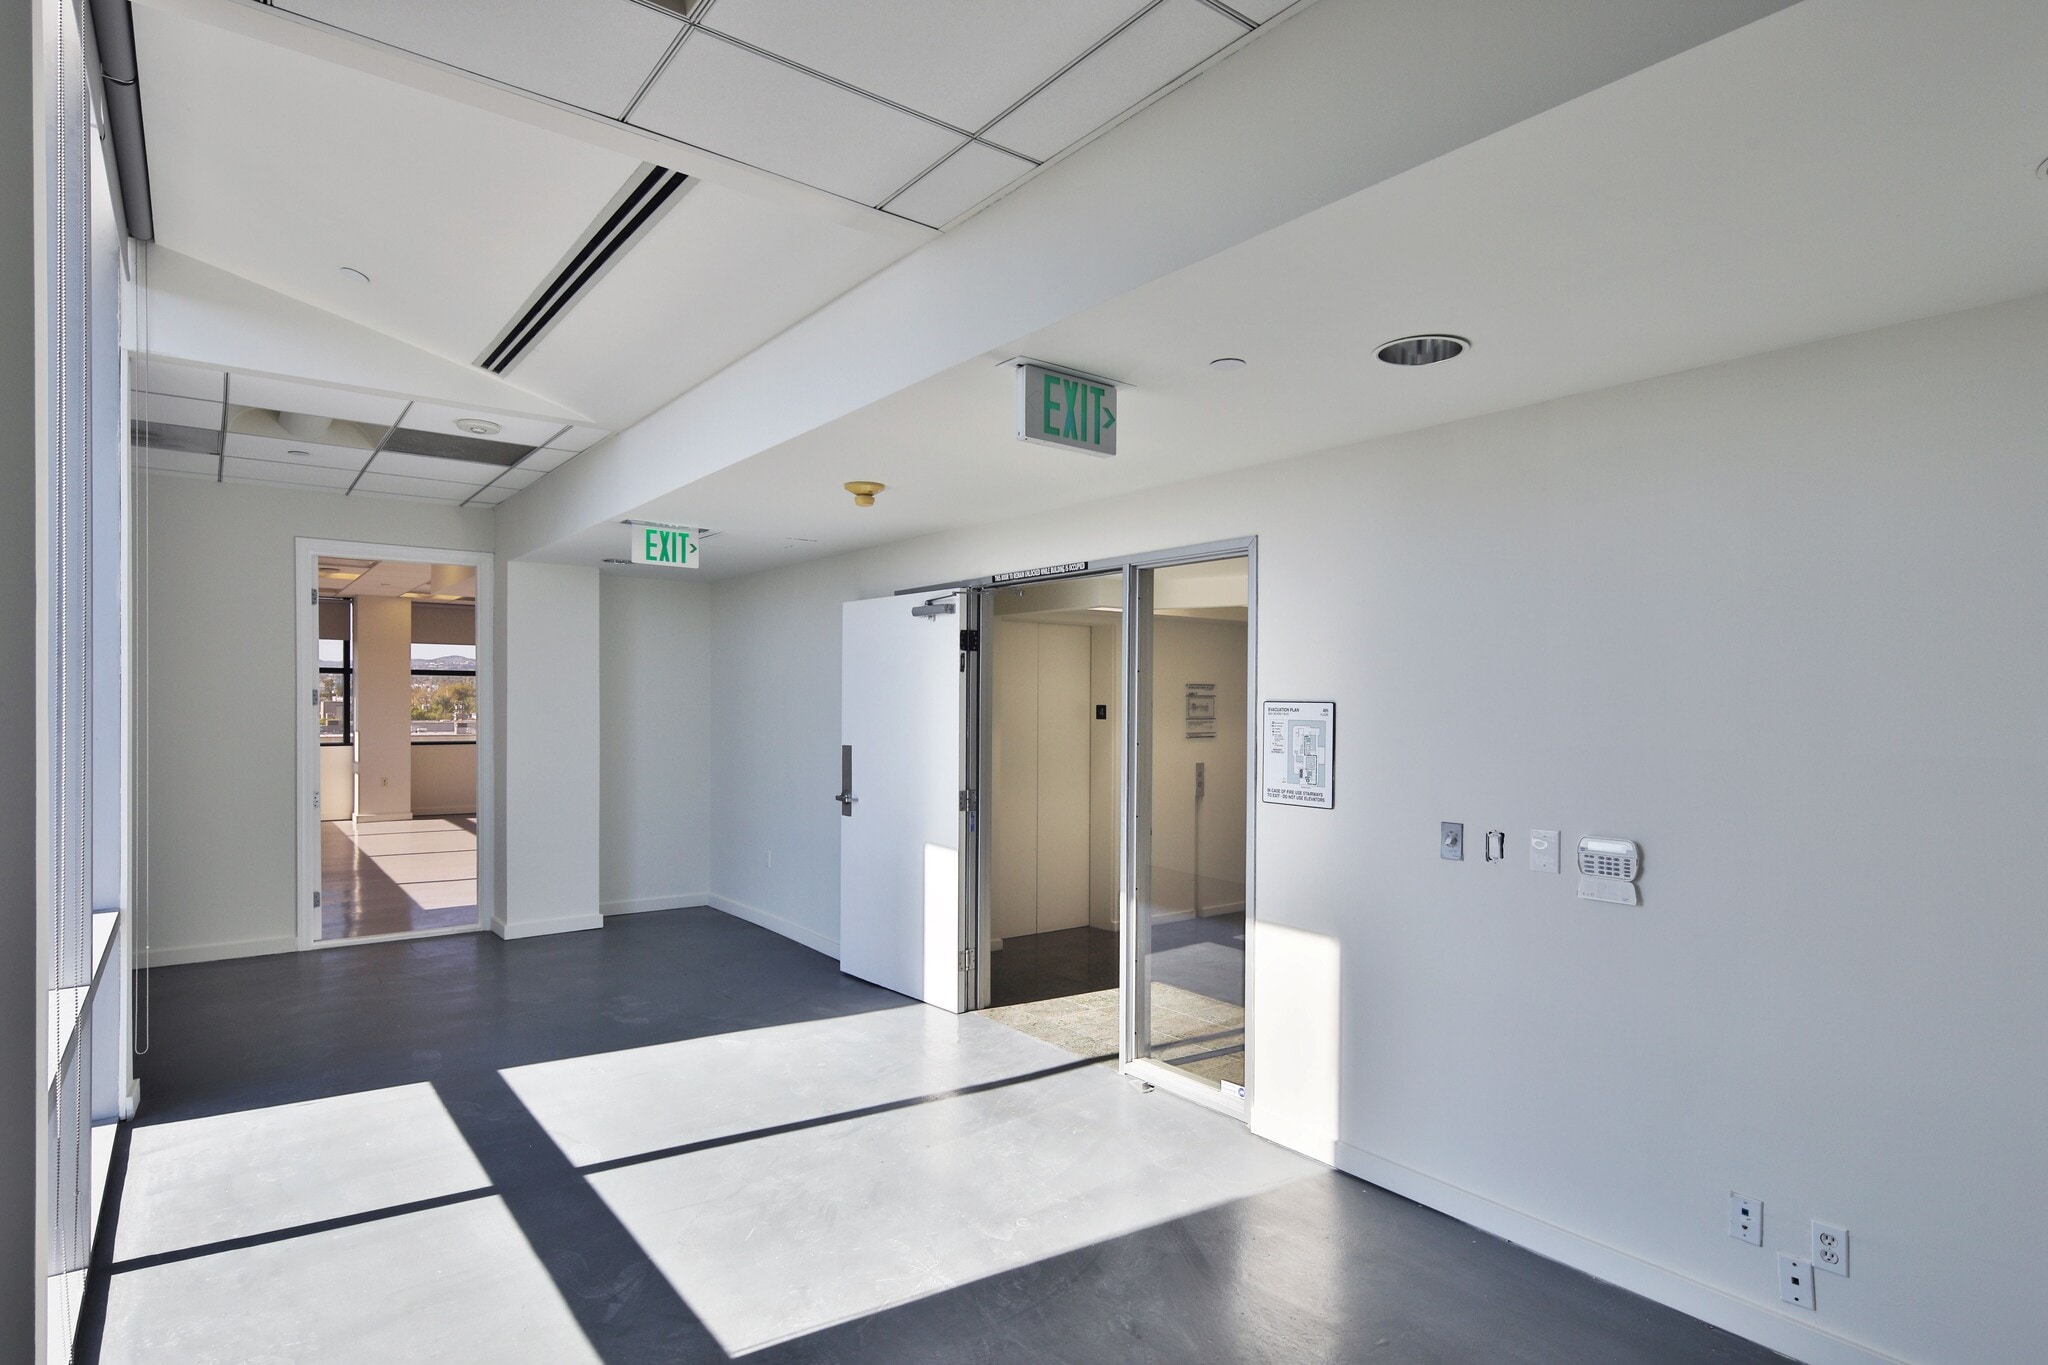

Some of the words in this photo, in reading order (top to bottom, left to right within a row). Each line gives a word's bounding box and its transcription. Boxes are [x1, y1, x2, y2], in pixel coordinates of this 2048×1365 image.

[1044, 374, 1105, 445] EXIT
[646, 529, 689, 563] EXIT
[1025, 569, 1040, 578] UNLOCKED
[1051, 565, 1065, 574] BUILDING
[1069, 562, 1085, 571] OCCUPIED
